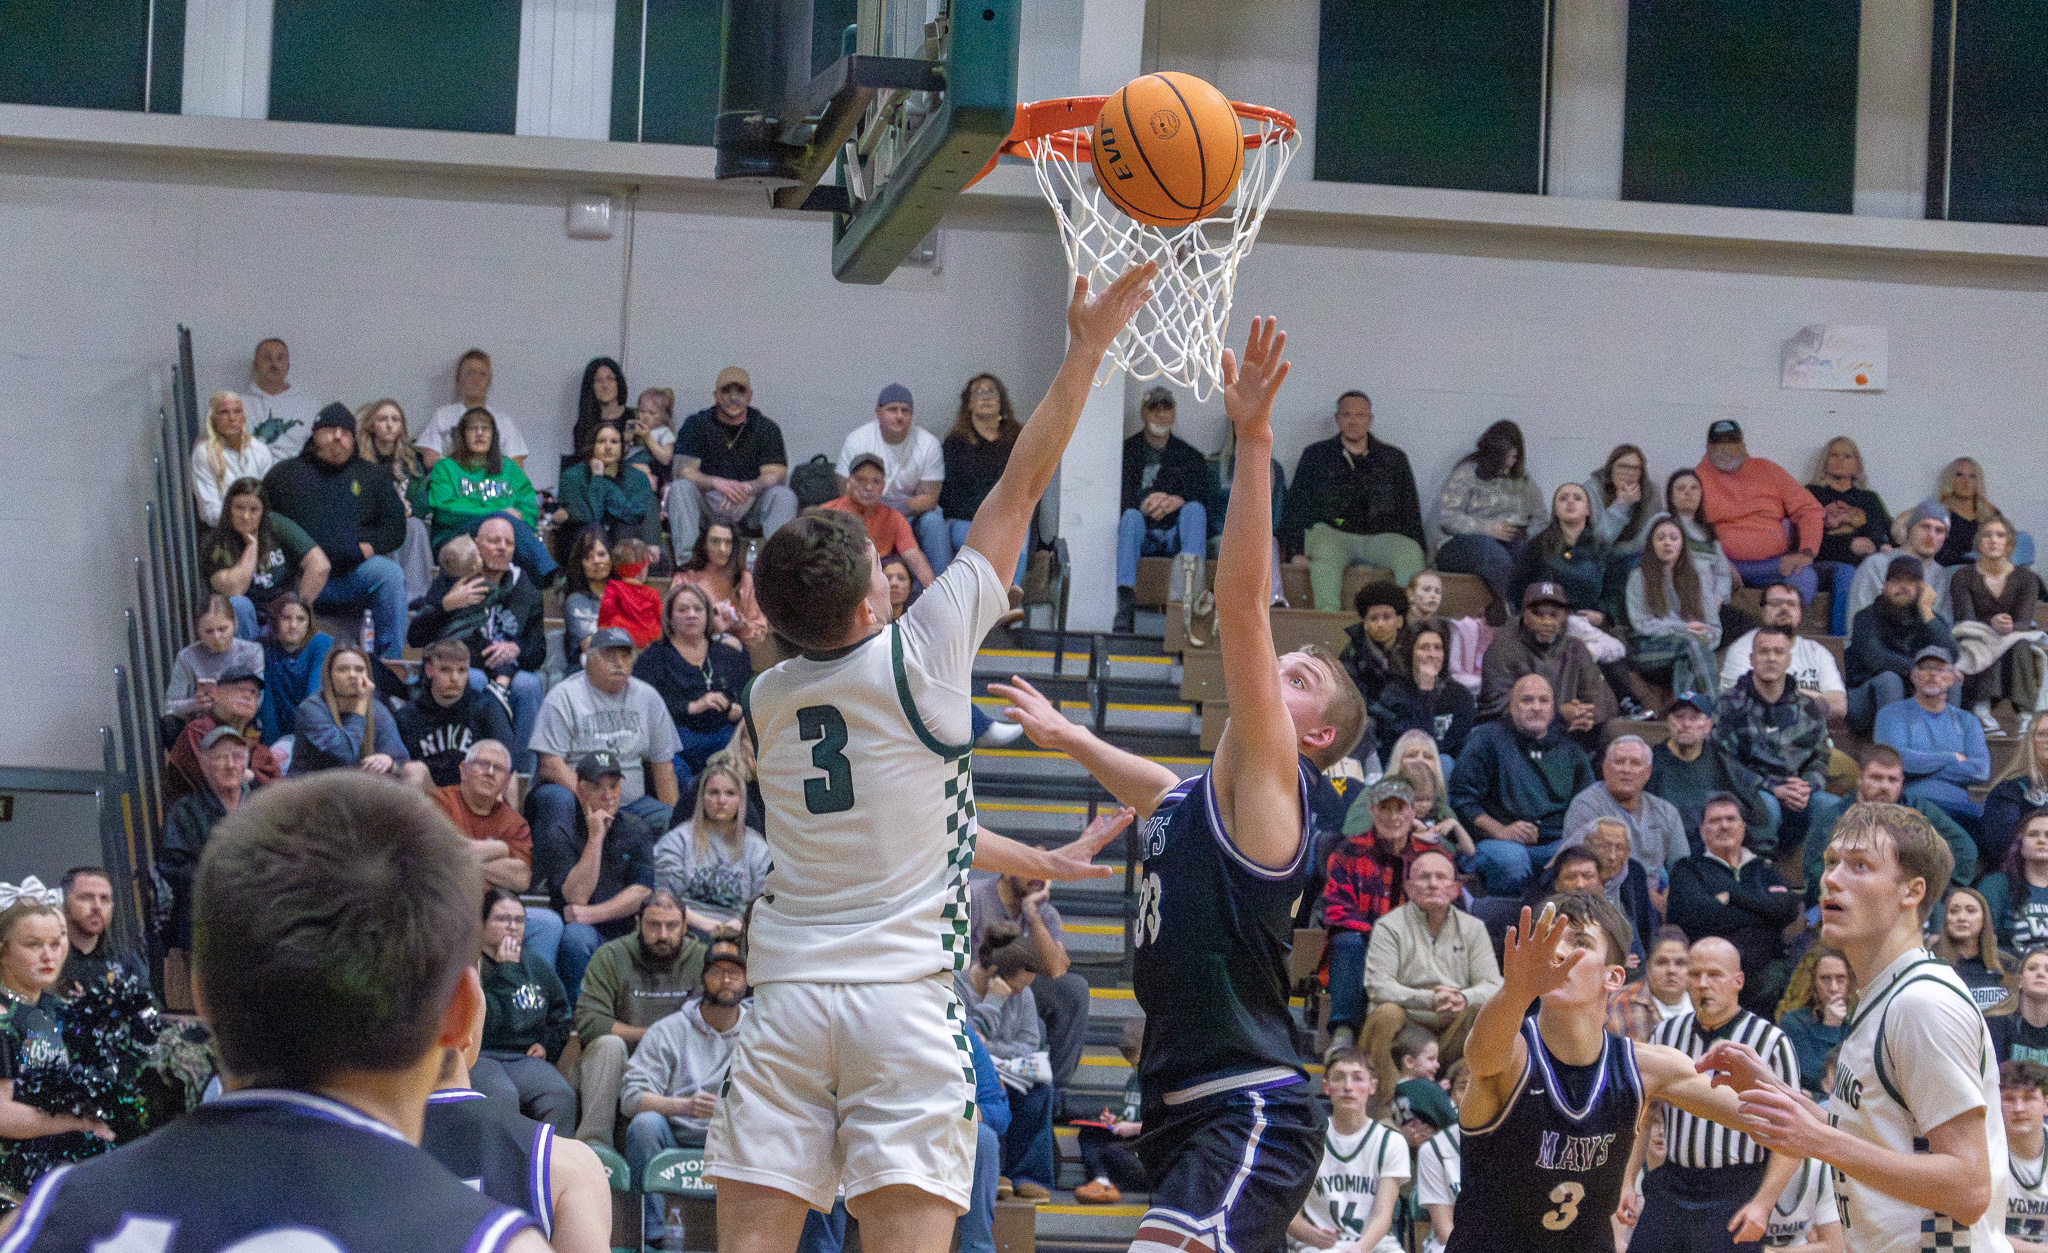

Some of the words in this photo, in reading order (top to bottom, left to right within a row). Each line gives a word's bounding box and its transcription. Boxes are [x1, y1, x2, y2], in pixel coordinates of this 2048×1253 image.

[1100, 127, 1134, 181] EVO
[419, 723, 474, 758] NIKE
[796, 704, 855, 815] 3
[1971, 988, 2009, 1004] RRIORS
[1535, 1130, 1616, 1172] MAVS
[1541, 1181, 1586, 1231] 3
[2007, 1197, 2048, 1215] YOMI
